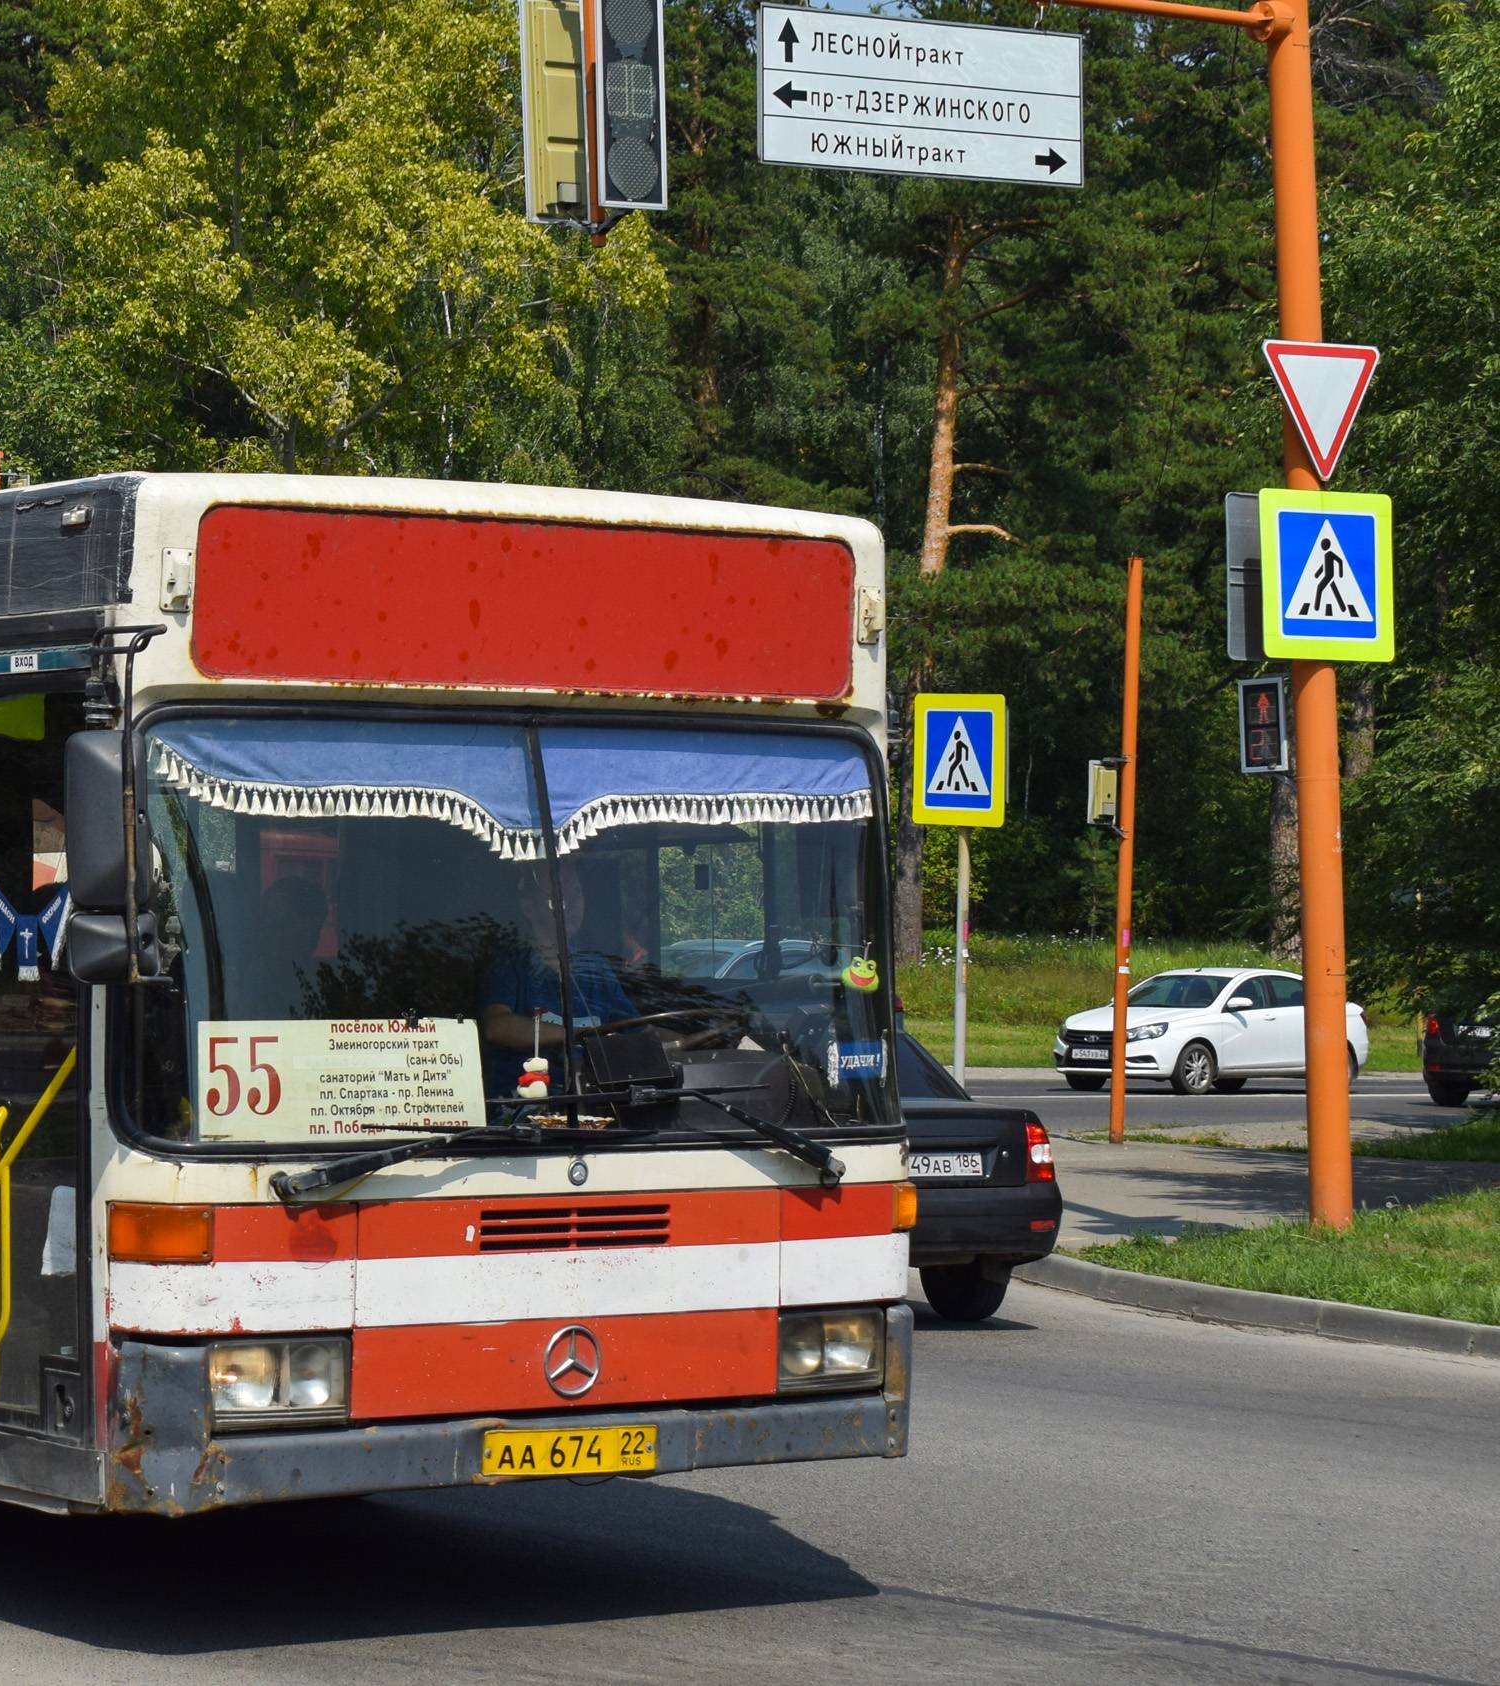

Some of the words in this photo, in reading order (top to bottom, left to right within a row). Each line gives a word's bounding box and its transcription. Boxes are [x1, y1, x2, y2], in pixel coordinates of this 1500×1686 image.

[15, 655, 34, 668] ВХОД
[331, 1020, 384, 1033] посёлок
[329, 1038, 409, 1051] Змеиногорский
[413, 1041, 439, 1051] тракт
[406, 1053, 437, 1067] (сан-й
[439, 1053, 463, 1067] Обь)
[206, 1036, 281, 1116] 55
[319, 1070, 376, 1085] санаторий
[413, 1072, 420, 1081] и
[320, 1090, 336, 1100] пл.
[339, 1087, 389, 1101] Спартака
[398, 1089, 414, 1100] пр.
[416, 1086, 454, 1098] Ленина
[311, 1106, 327, 1116] пл.
[330, 1104, 375, 1118] Октября
[385, 1105, 401, 1117] пр.
[404, 1101, 464, 1116] Строителей
[309, 1123, 329, 1135] пл.
[910, 1155, 951, 1174] 49АВ
[955, 1154, 978, 1168] 186
[550, 1435, 602, 1468] 674
[620, 1431, 645, 1456] 22
[622, 1457, 642, 1466] RUS
